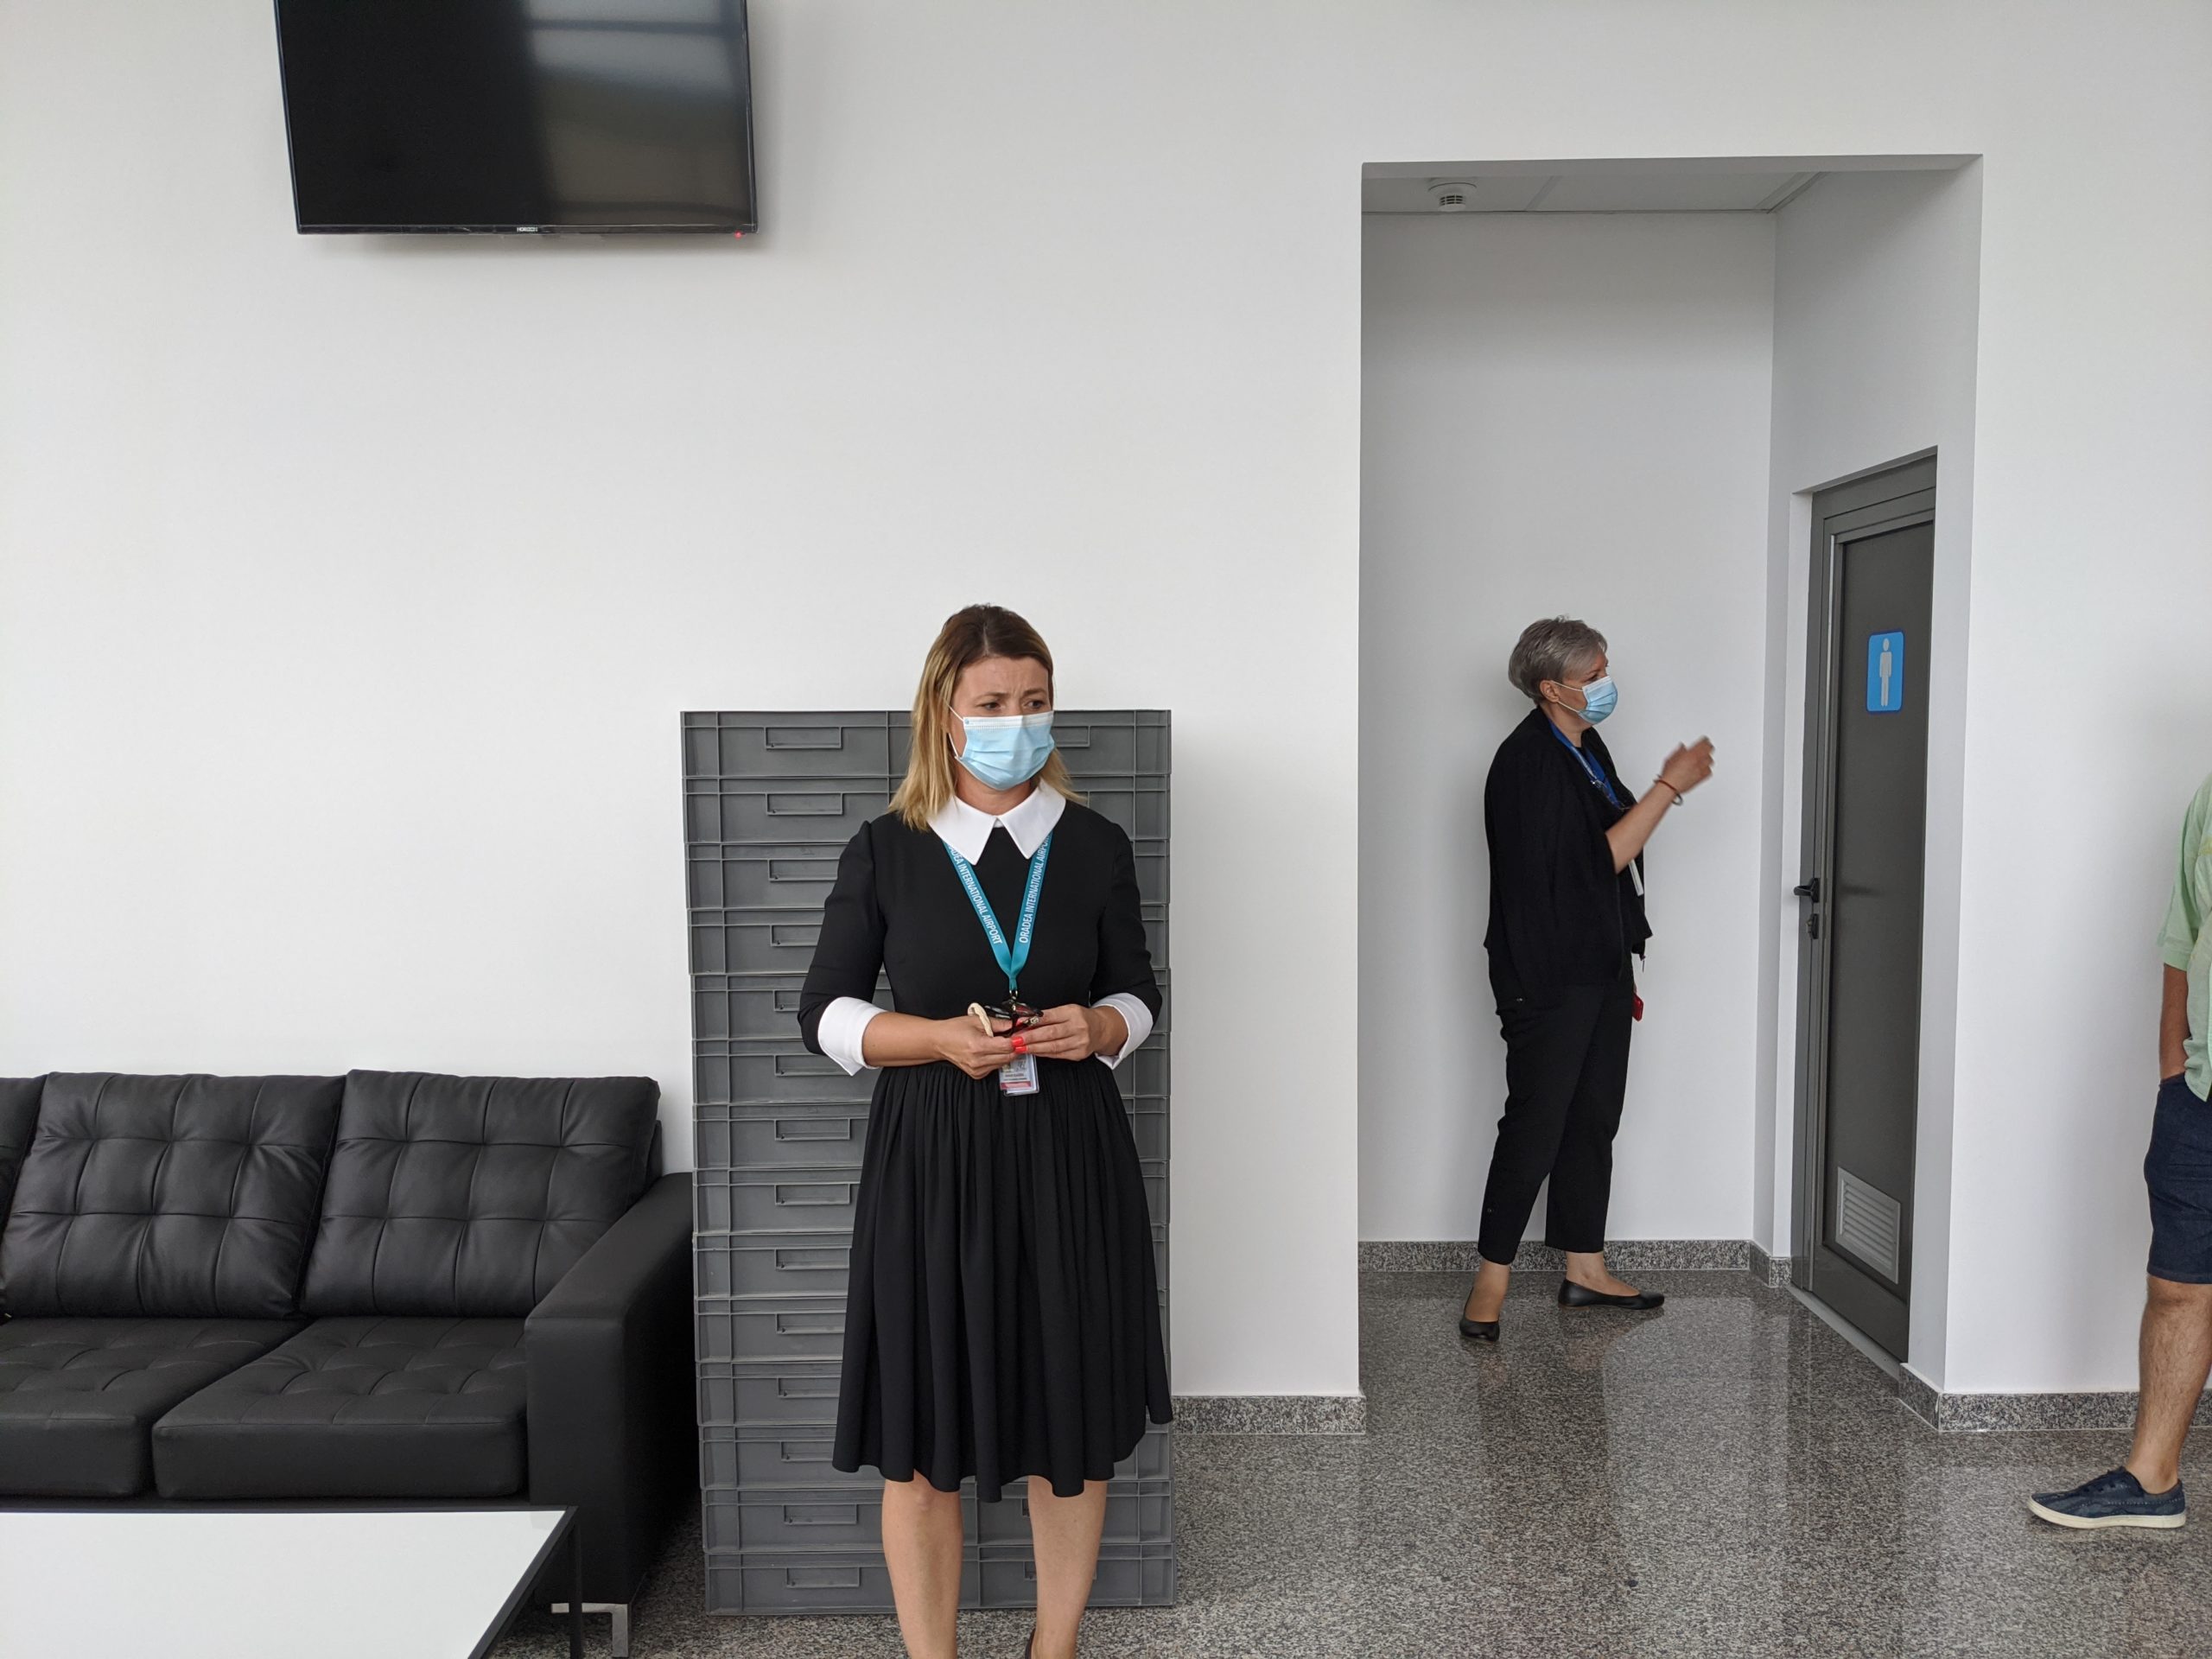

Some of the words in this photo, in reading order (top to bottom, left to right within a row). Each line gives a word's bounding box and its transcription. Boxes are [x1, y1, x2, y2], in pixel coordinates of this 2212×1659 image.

[957, 862, 988, 917] INTERNATIONAL
[982, 915, 1003, 944] AIRPORT
[1025, 862, 1044, 915] INTERNATIONAL
[1019, 913, 1033, 944] ORADEA
